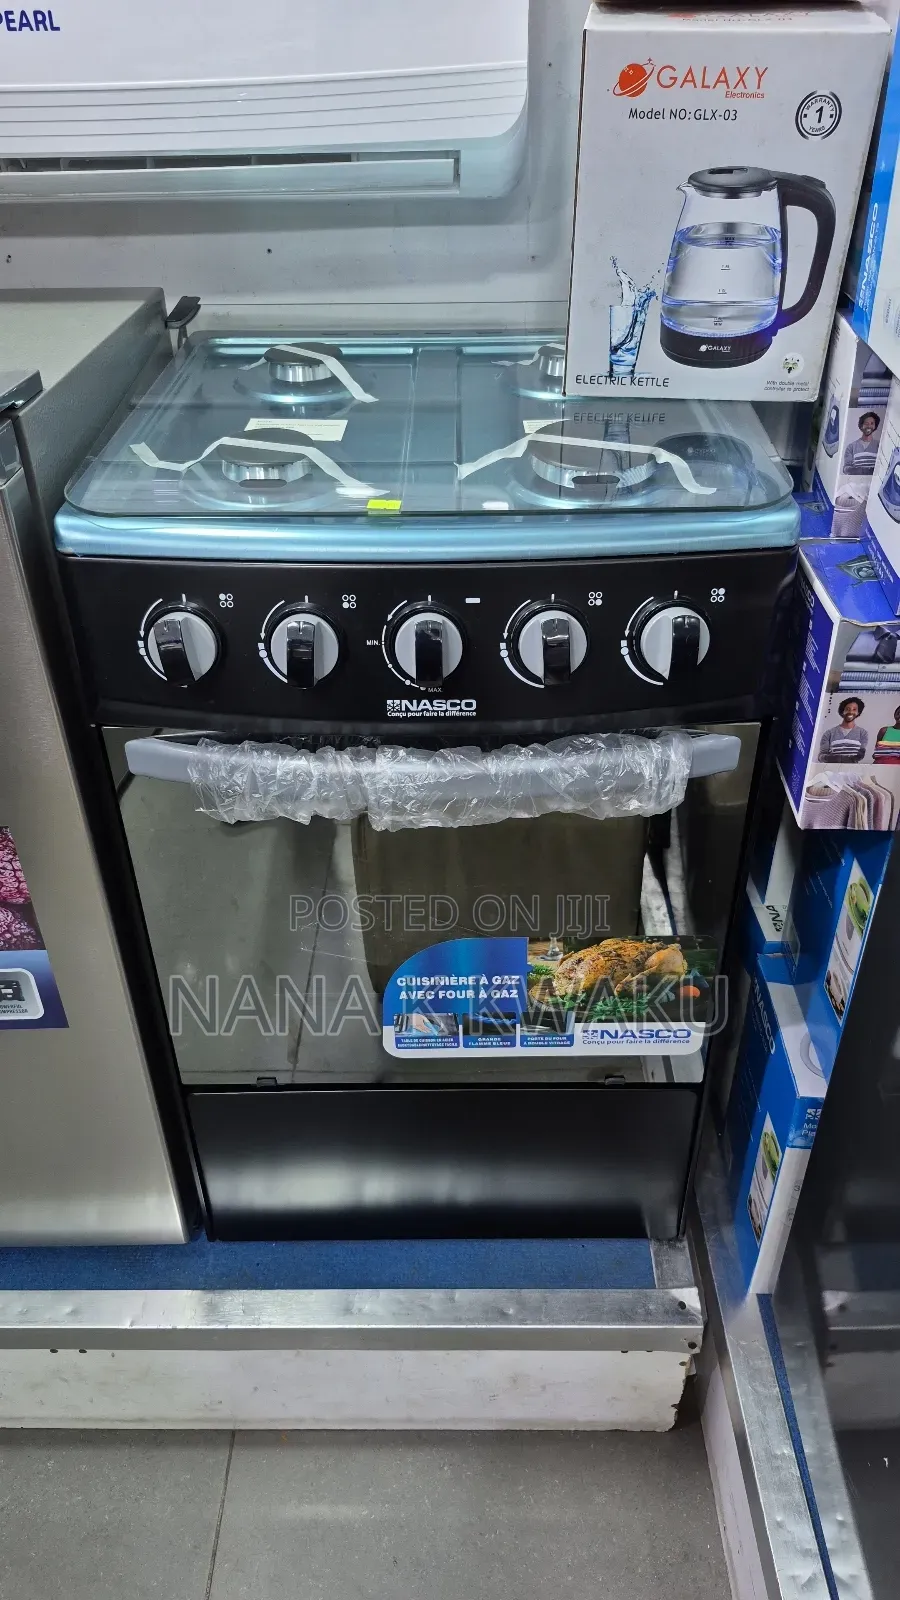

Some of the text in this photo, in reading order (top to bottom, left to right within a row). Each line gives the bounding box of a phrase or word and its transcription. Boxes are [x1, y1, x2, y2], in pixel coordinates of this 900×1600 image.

[656, 65, 769, 89] GALAXY
[725, 91, 765, 99] Electronics
[805, 98, 835, 111] WARRANTY
[628, 108, 666, 120] Model
[815, 106, 824, 123] 1
[861, 202, 878, 284] NASCO
[575, 374, 670, 387] ELECTRIC KETTLE
[401, 699, 477, 711] NASCO
[396, 973, 520, 986] CUISINIÈRE À GAZ
[399, 988, 519, 1000] AVEC FOUR À GAZ
[600, 1028, 692, 1039] NASCO
